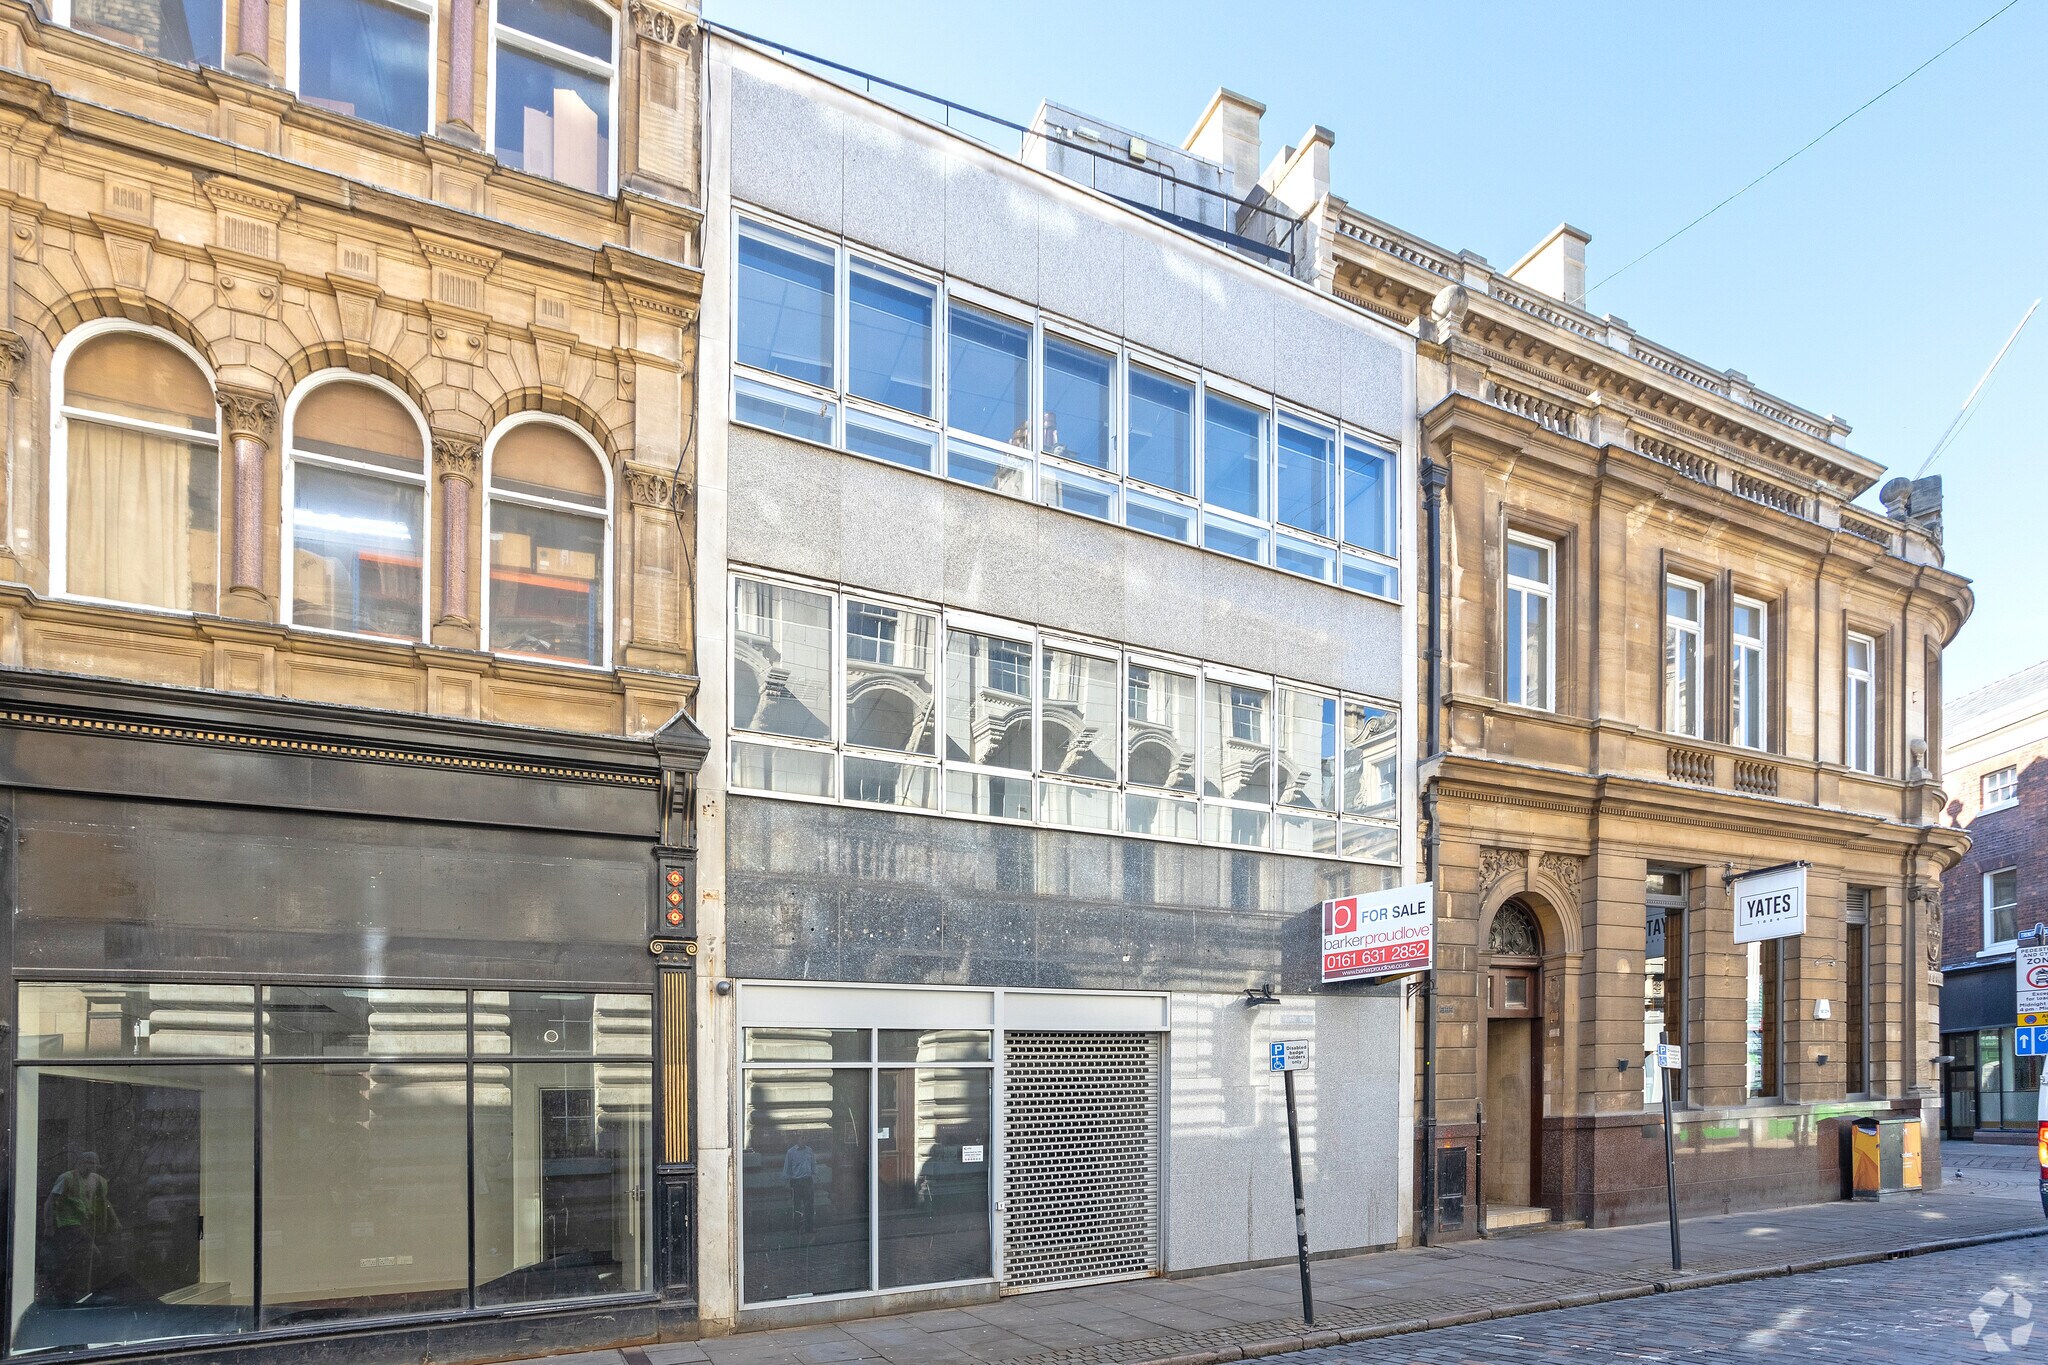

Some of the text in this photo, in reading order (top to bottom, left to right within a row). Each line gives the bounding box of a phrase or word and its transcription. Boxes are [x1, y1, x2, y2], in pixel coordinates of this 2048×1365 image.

[1361, 901, 1426, 923] FOR SALE
[1747, 894, 1791, 918] YATES
[1324, 925, 1430, 951] barkerproudlove
[1327, 942, 1425, 969] 0161 631 2852
[1275, 1045, 1282, 1055] P
[1661, 1046, 1666, 1054] P
